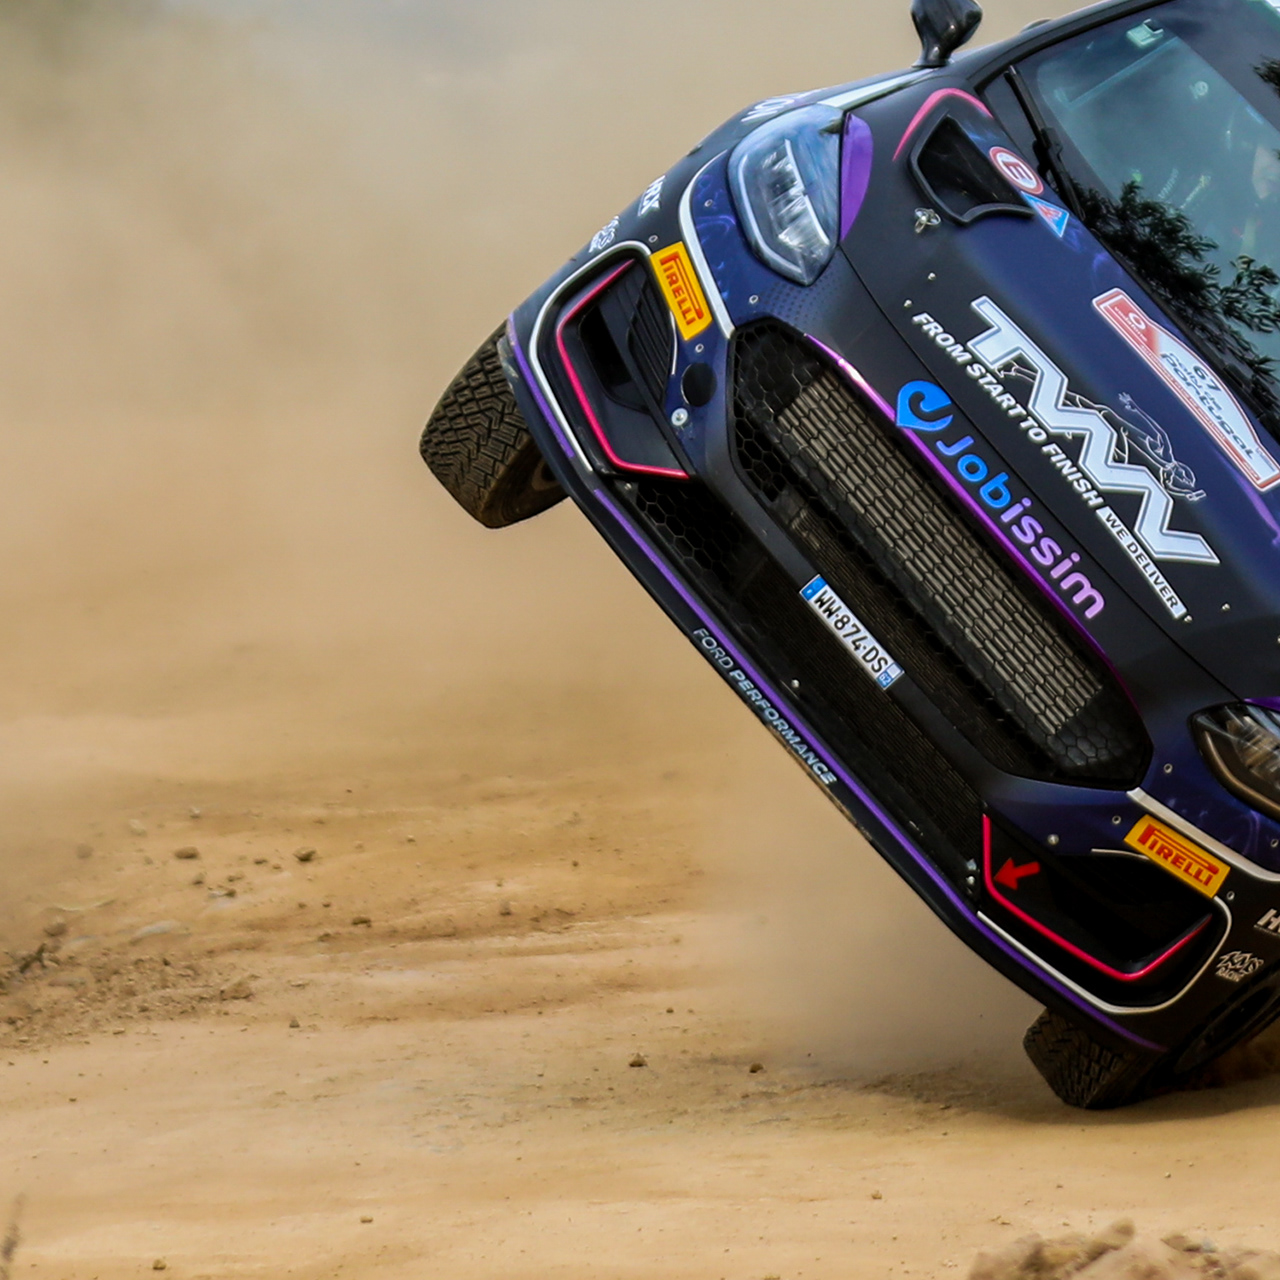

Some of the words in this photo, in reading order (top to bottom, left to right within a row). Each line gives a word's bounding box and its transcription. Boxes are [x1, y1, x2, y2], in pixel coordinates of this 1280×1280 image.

[659, 251, 704, 326] PIRELLI
[1192, 365, 1222, 392] 67
[912, 312, 972, 365] FROM
[966, 361, 1027, 420] START
[1019, 412, 1047, 443] TO
[1041, 442, 1105, 507] FINISH
[1104, 512, 1125, 541] WE
[1125, 542, 1179, 610] DELIVER
[935, 435, 1105, 619] Jobissim
[693, 628, 734, 669] FORD
[730, 669, 838, 785] PERFORMANCE
[878, 673, 891, 686] 62
[1137, 823, 1219, 886] PIRELLI
